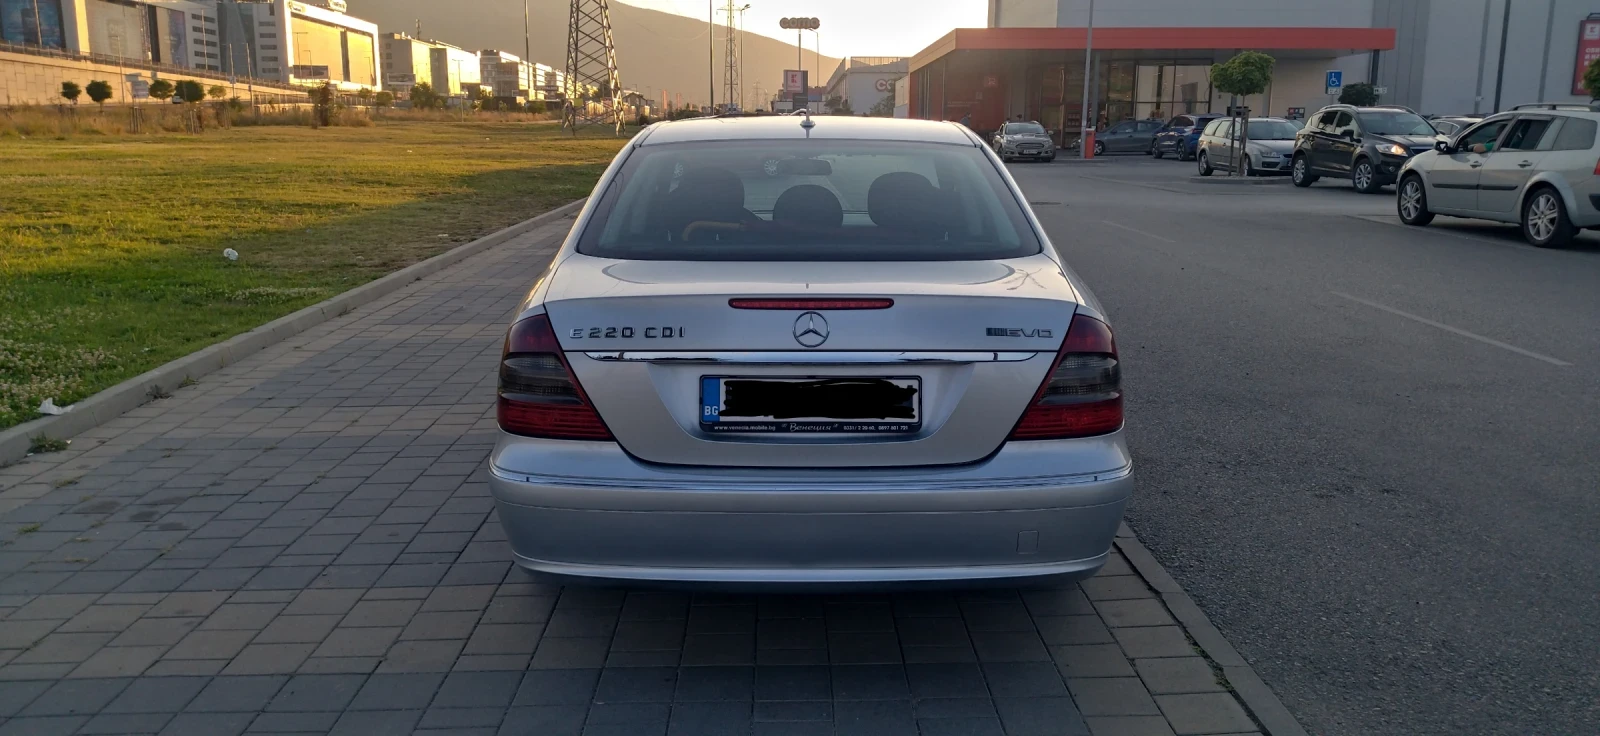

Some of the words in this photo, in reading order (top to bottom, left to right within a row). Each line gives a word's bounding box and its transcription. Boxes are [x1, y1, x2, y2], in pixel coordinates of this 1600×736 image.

[569, 328, 584, 339] E
[587, 326, 636, 339] 220
[644, 326, 685, 339] CDI
[704, 405, 719, 416] BG
